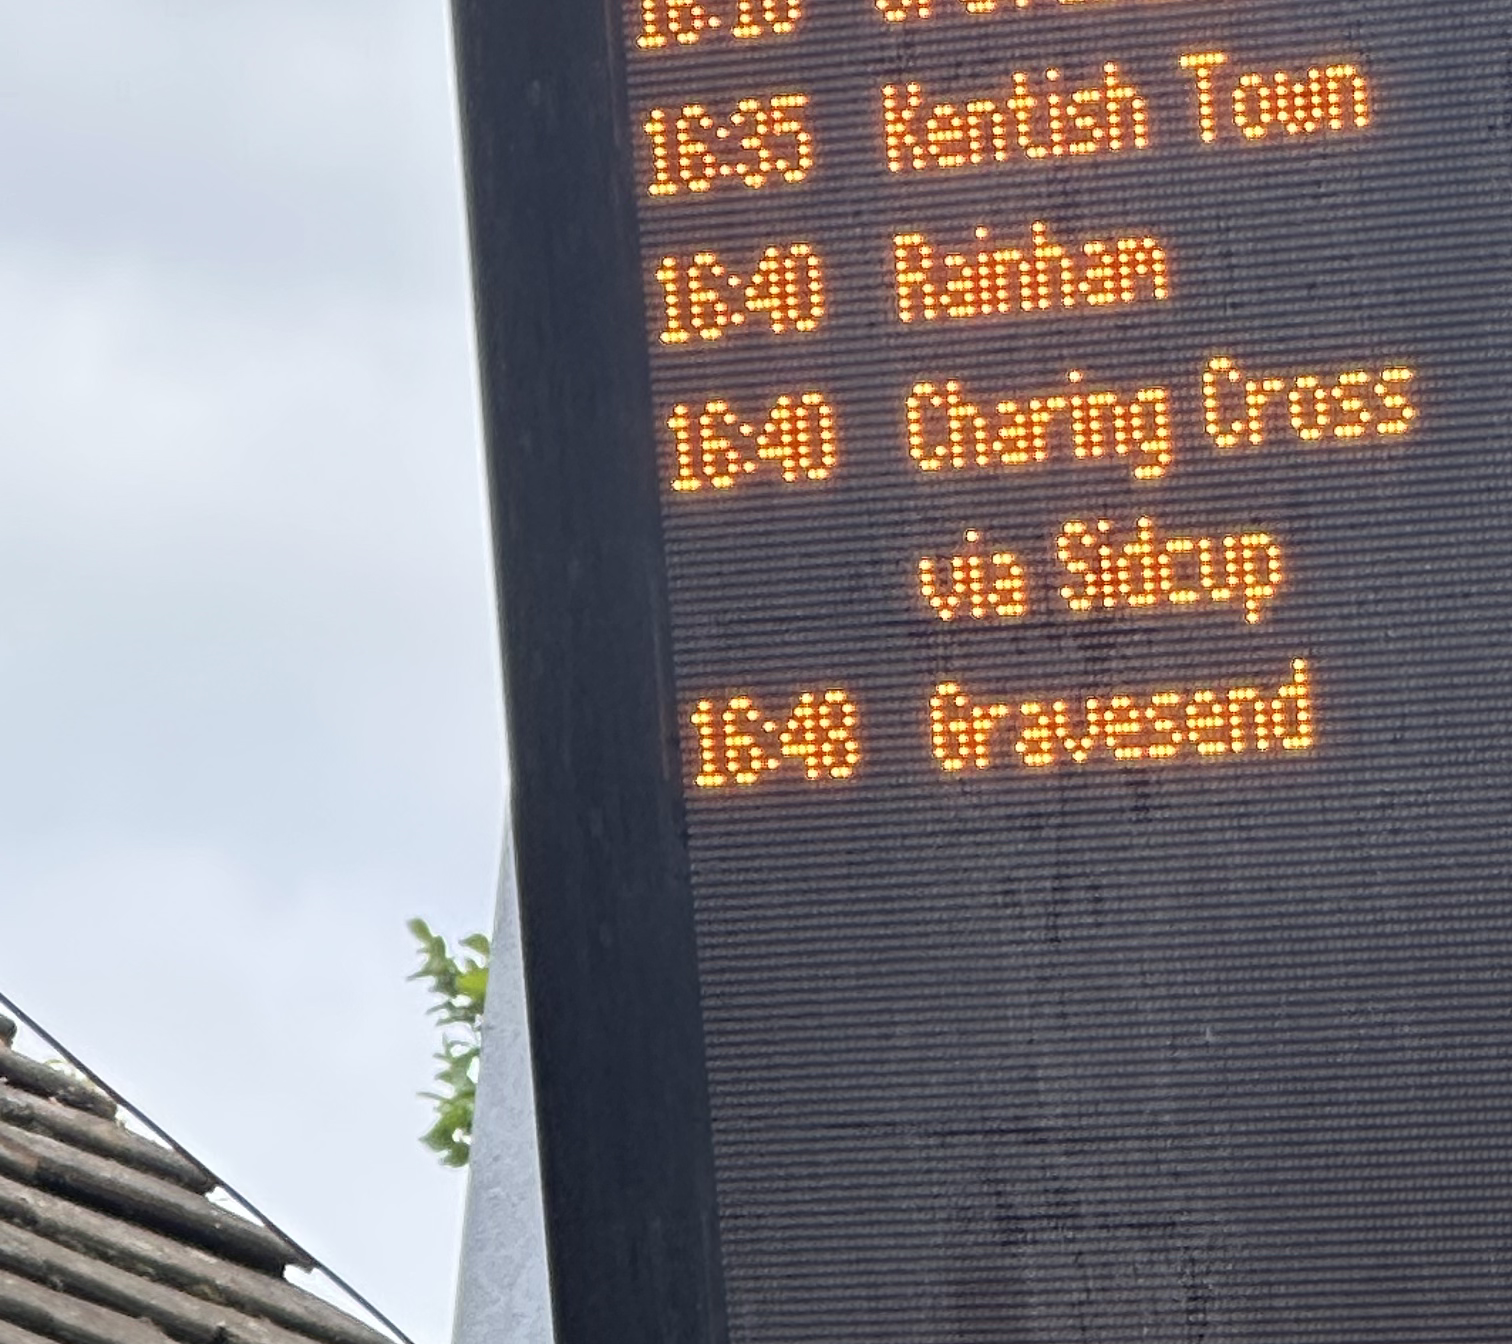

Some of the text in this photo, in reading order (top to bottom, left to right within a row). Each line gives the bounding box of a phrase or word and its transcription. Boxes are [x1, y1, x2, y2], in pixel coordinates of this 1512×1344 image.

[643, 92, 813, 197] 16:35
[880, 60, 1148, 172] Kentish
[1179, 50, 1372, 142] Town
[655, 241, 826, 344] 16:40
[892, 219, 1169, 323] Rainham
[667, 391, 838, 492] 16:40
[905, 367, 1174, 481] Charing
[1203, 354, 1418, 449] Cross
[918, 515, 1284, 625] via Sidcup
[690, 688, 861, 788] 16:48
[929, 656, 1315, 772] Gravesend
